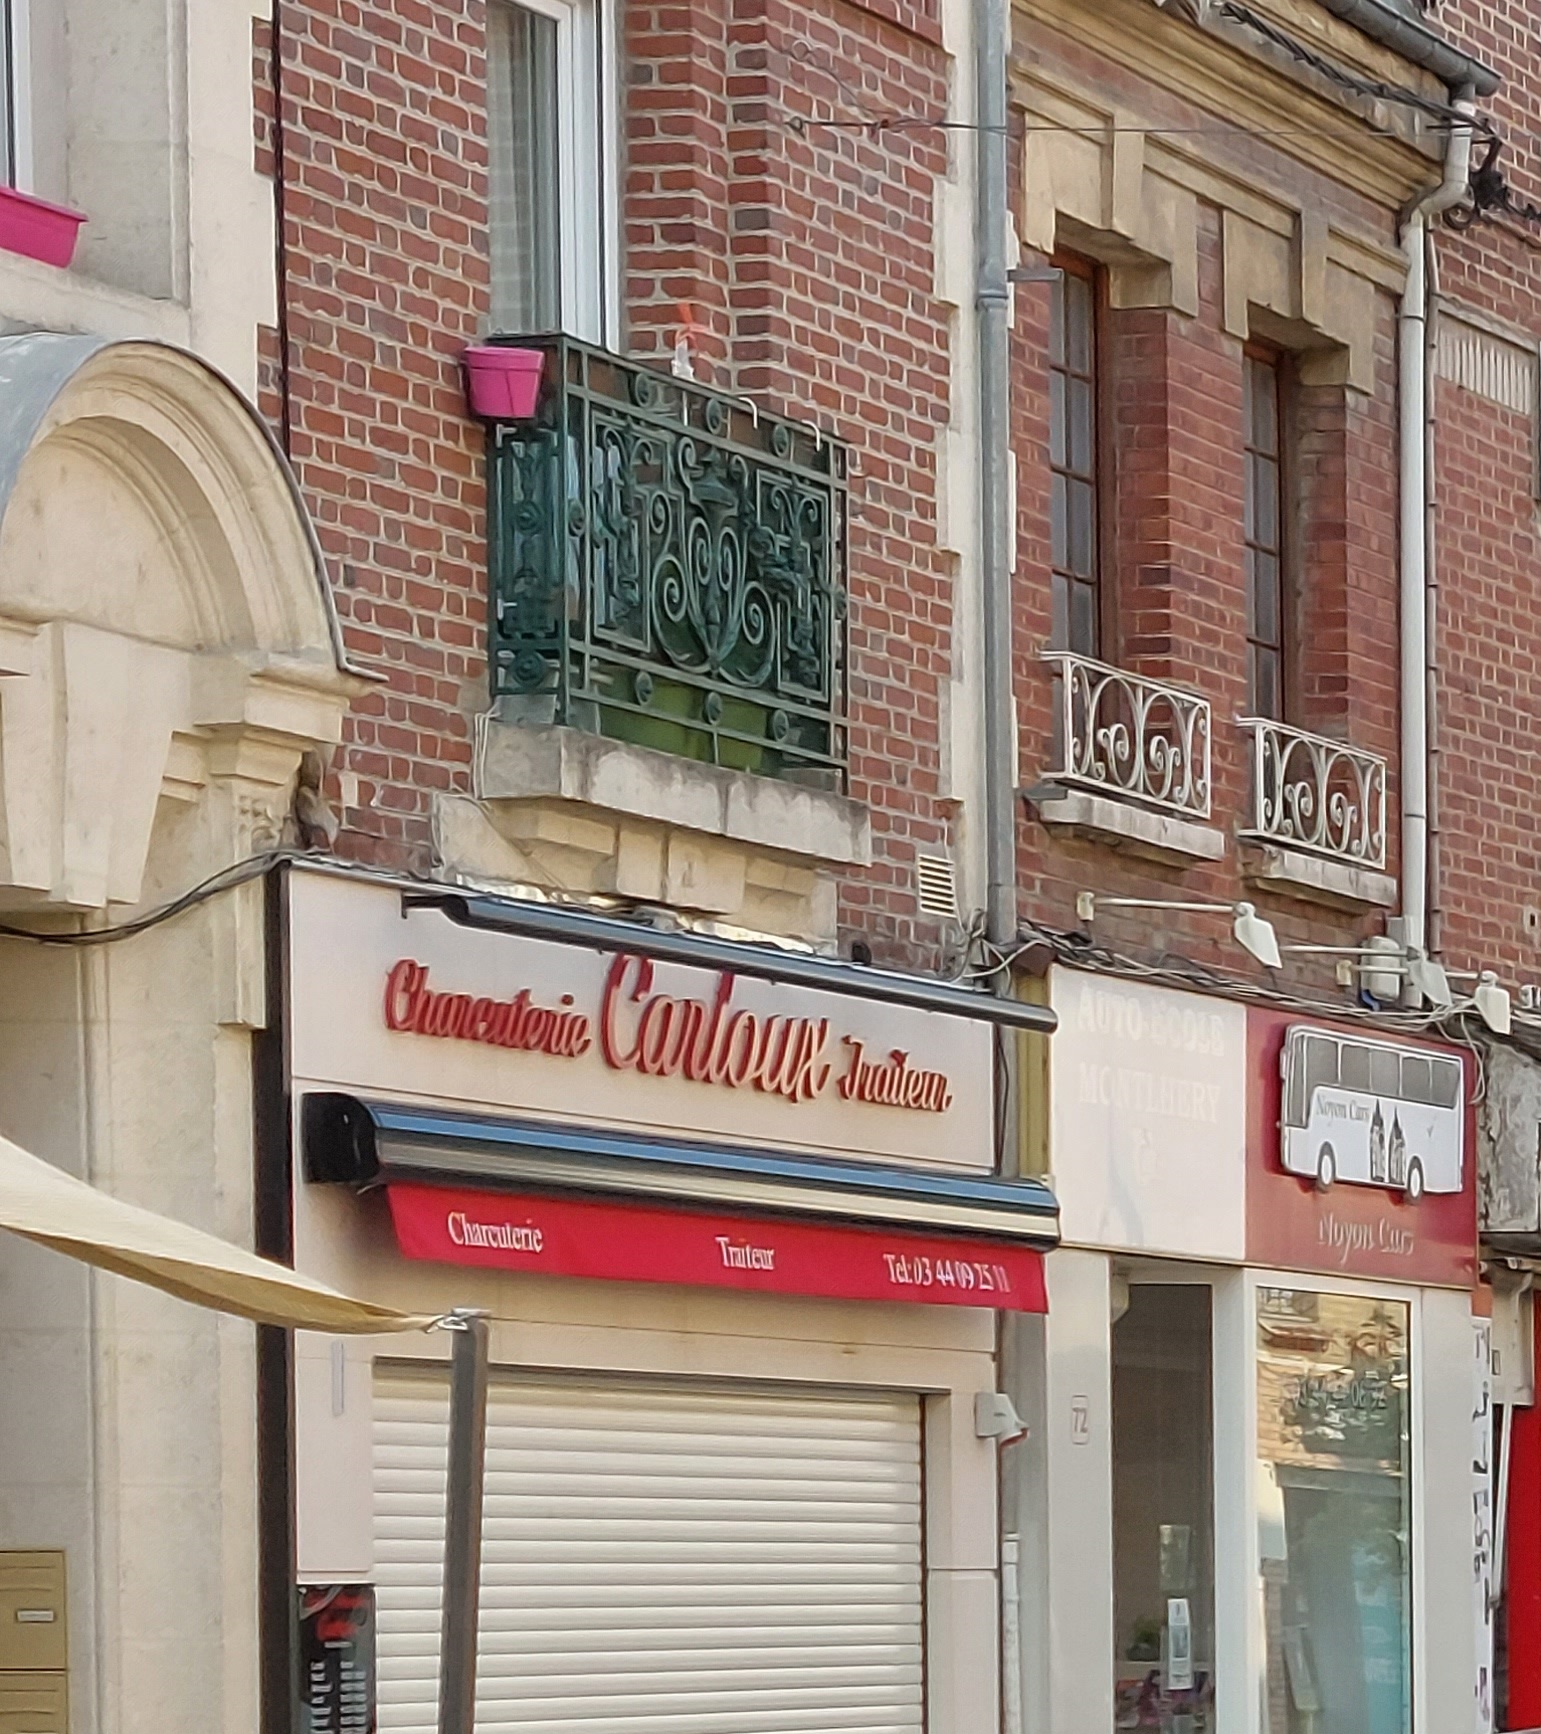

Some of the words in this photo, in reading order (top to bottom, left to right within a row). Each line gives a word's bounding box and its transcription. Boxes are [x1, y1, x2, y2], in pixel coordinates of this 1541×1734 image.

[384, 958, 592, 1057] Charcuterie
[838, 1034, 953, 1112] Traiteur
[1316, 1093, 1347, 1126] Noyon
[447, 1210, 544, 1254] Charcuterie
[714, 1235, 775, 1272] Traiteur
[935, 1259, 956, 1288] 44
[1319, 1211, 1375, 1267] Noyon
[1378, 1217, 1414, 1255] Cars
